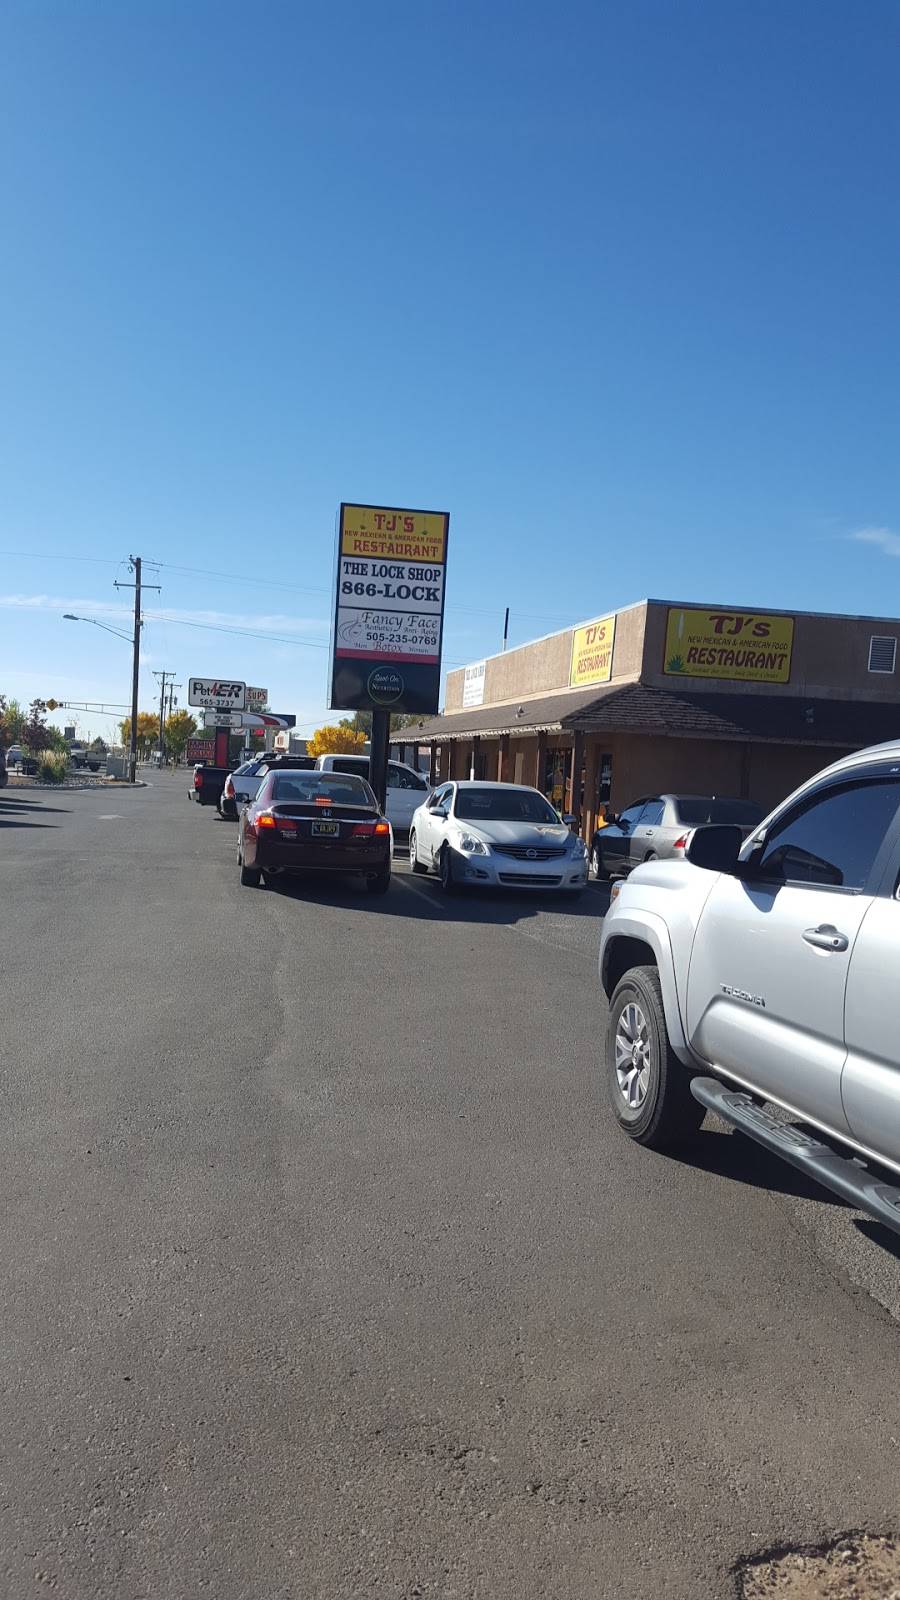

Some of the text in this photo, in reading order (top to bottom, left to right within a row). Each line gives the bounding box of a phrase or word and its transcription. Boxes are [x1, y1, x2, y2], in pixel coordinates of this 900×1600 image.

[360, 531, 387, 540] MEXICAN
[394, 534, 424, 543] AMERICAN
[353, 539, 439, 558] RESTAURANT
[343, 562, 441, 582] THE LOCK SHOP
[342, 581, 441, 602] 866-LOCK
[361, 612, 437, 632] Fancy Face
[366, 633, 437, 645] 505-235-0769
[687, 635, 702, 643] NEW
[703, 637, 730, 646] MEXICAN
[739, 640, 770, 649] AMERICAN
[771, 642, 788, 650] FOOD
[686, 647, 787, 670] RESTAURANT
[193, 682, 211, 695] Pet
[200, 699, 235, 707] 565-3737
